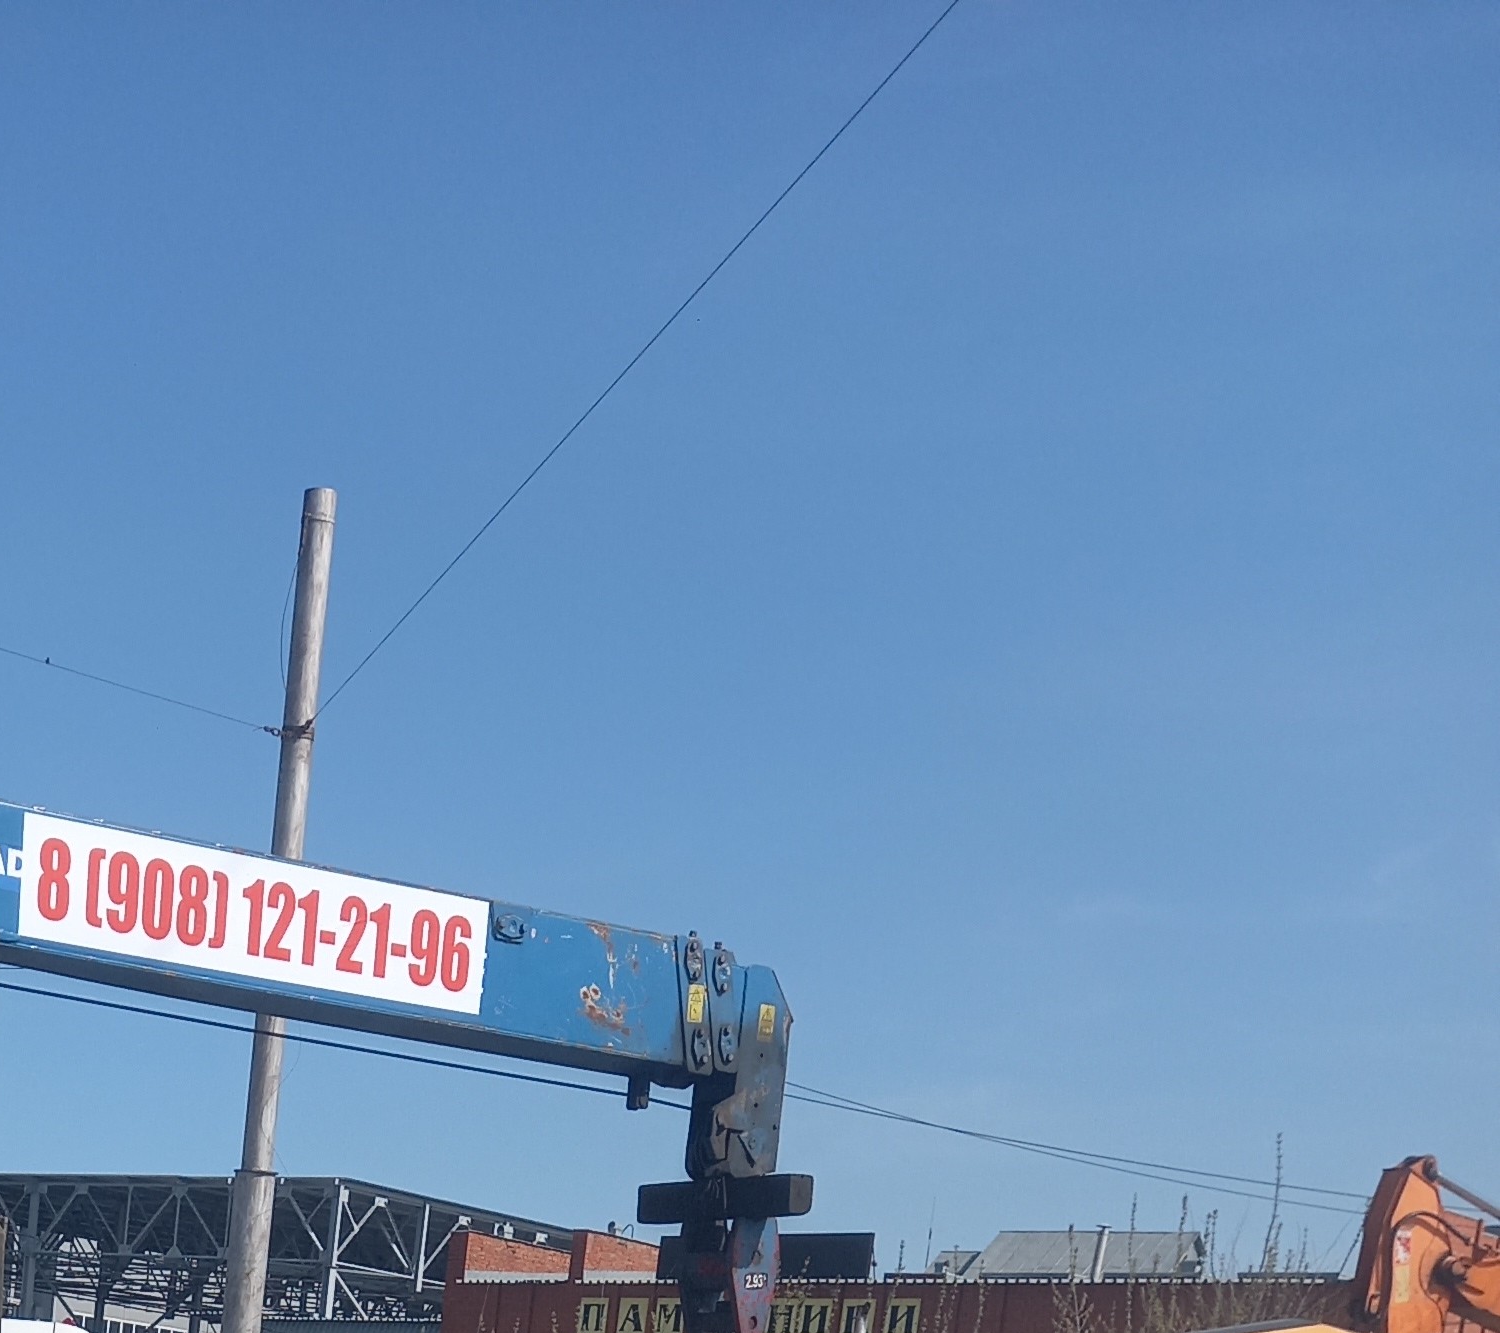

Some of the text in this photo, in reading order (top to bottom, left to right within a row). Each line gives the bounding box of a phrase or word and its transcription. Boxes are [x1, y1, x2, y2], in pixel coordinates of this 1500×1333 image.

[37, 837, 473, 993] 8 (908) 121-21-96
